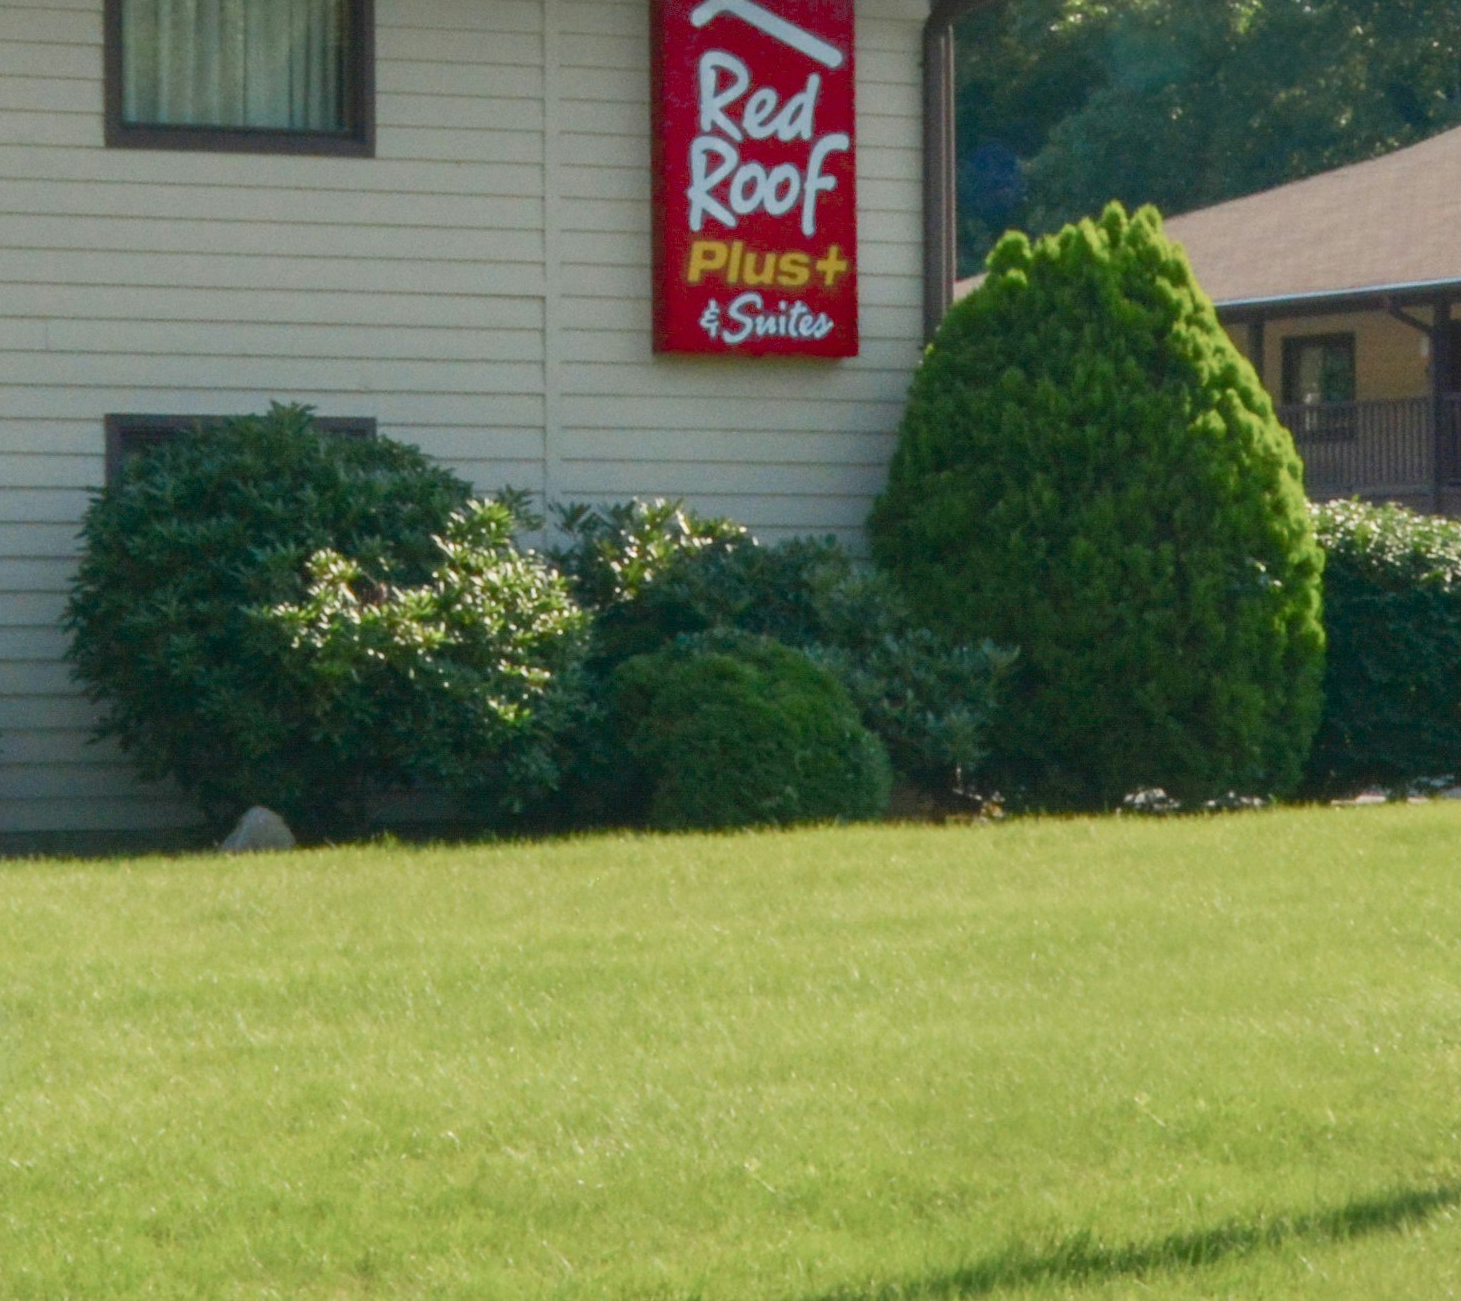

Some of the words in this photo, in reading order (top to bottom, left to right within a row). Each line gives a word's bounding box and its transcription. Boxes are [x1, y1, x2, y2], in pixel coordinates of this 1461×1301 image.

[699, 50, 820, 141] Red
[688, 133, 850, 236] Roof
[687, 239, 847, 286] Plus+
[699, 299, 721, 339] &
[722, 293, 834, 344] Suites
